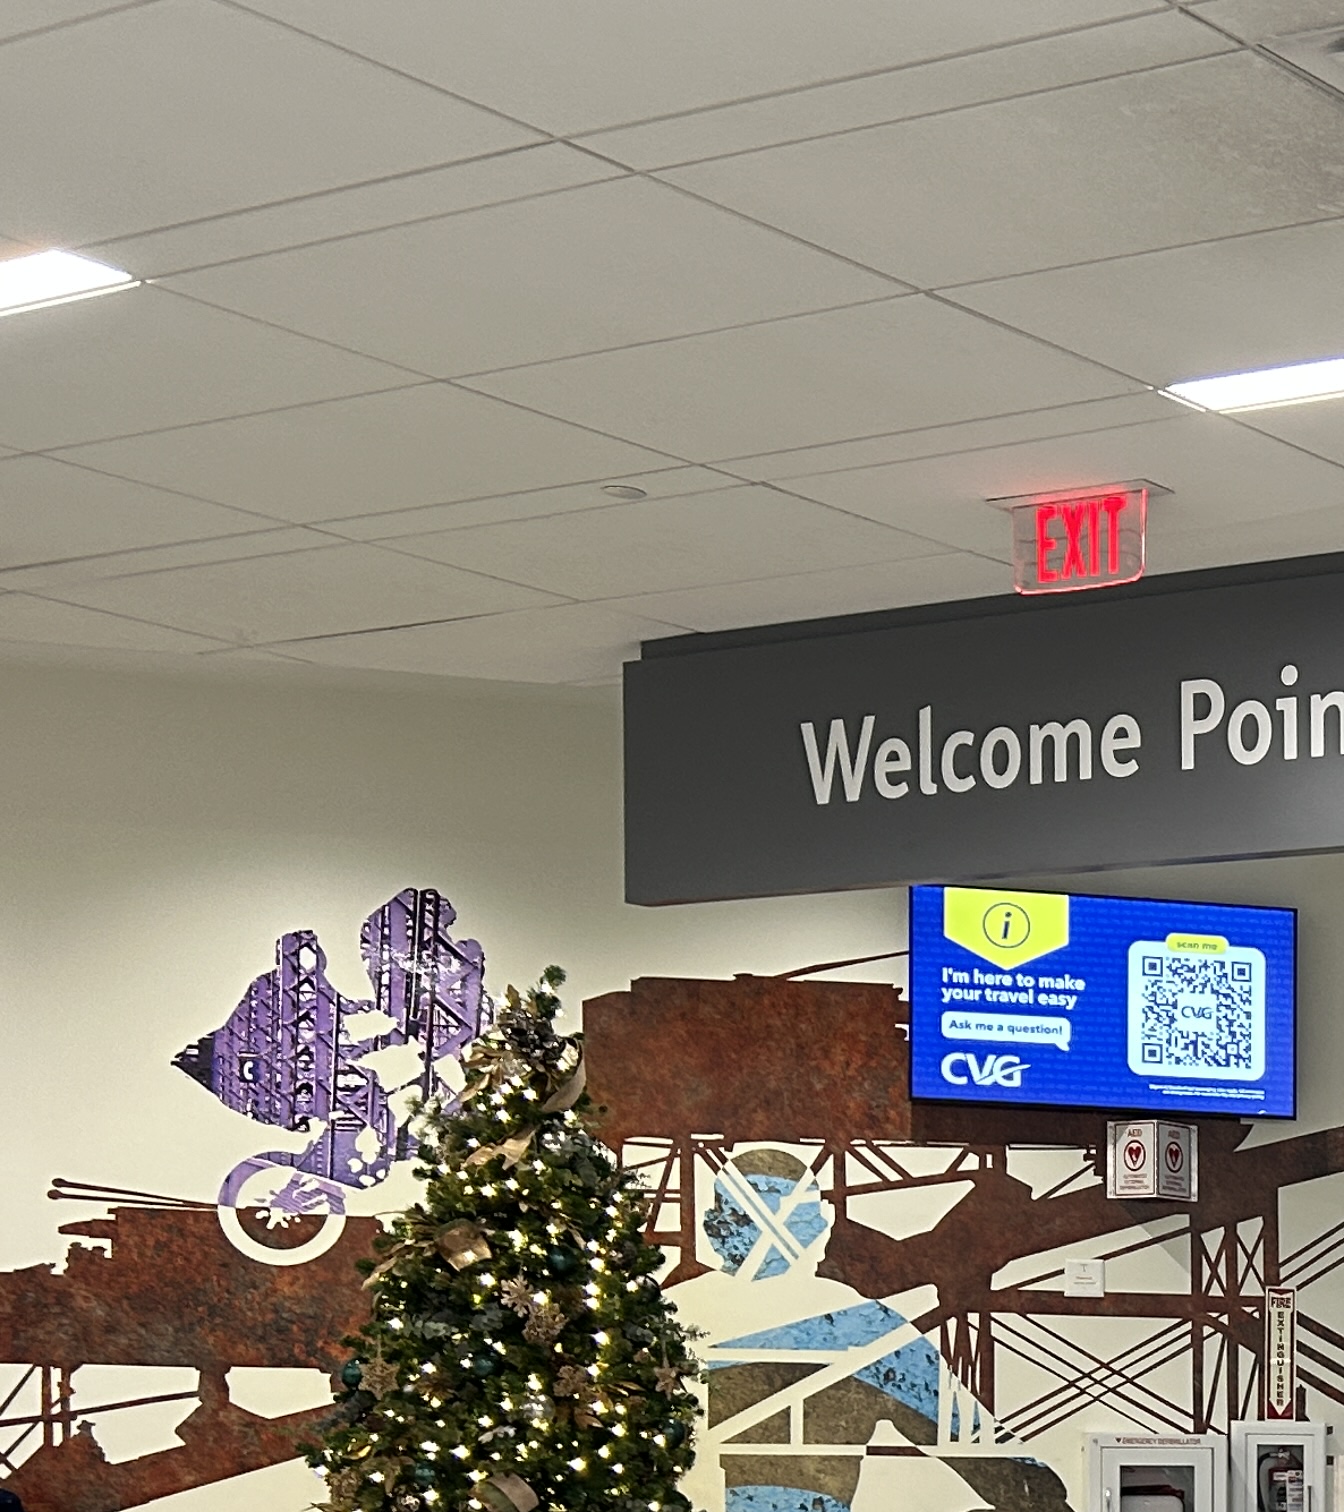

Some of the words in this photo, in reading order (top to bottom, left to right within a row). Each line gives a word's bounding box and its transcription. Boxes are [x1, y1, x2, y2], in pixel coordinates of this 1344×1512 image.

[1036, 496, 1127, 583] EXIT
[800, 705, 1142, 804] Welcome
[1176, 940, 1199, 949] scan
[1201, 942, 1218, 951] me
[941, 967, 970, 984] I'm
[973, 968, 1013, 986] here
[1015, 973, 1036, 988] to
[1038, 974, 1086, 991] make
[941, 987, 982, 1003] your
[984, 988, 1034, 1005] travel
[1037, 993, 1078, 1011] easy
[1181, 1004, 1213, 1020] CVG
[949, 1019, 972, 1030] Ask
[975, 1022, 993, 1031] me
[997, 1024, 1003, 1032] a
[1007, 1024, 1063, 1036] question!
[941, 1052, 1025, 1087] CVG
[1271, 1296, 1292, 1309] FIRE
[1276, 1311, 1285, 1407] EXTINGUISHER
